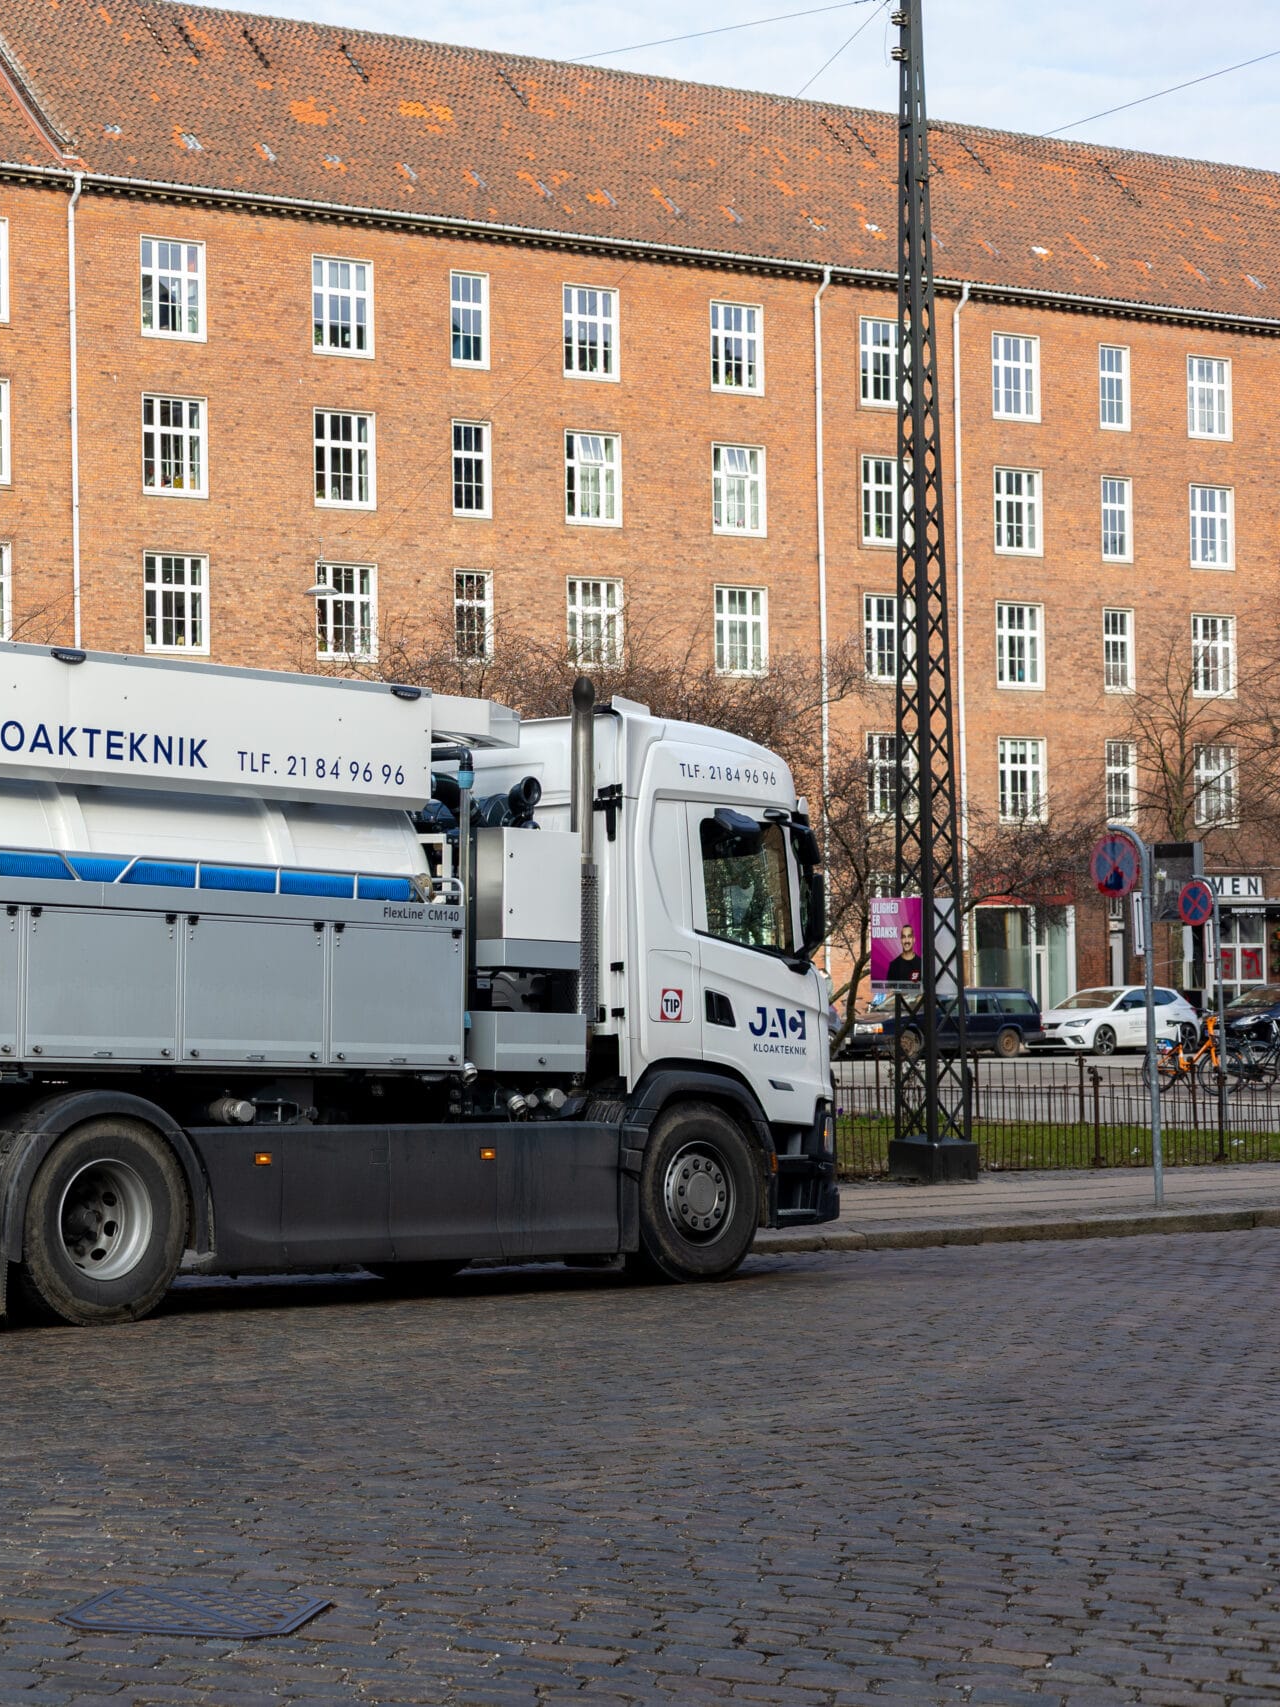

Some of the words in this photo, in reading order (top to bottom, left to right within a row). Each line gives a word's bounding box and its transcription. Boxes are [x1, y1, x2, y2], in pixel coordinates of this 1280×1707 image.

[237, 750, 278, 774] TLF.
[286, 755, 307, 777] 21
[315, 758, 341, 780] 84
[349, 761, 373, 783] 96
[381, 764, 405, 785] 96
[680, 763, 705, 779] TLF.
[709, 765, 721, 780] 21
[725, 767, 740, 782] 84
[744, 769, 759, 784] 96
[762, 771, 777, 786] 96
[1211, 877, 1259, 895] MEN
[428, 909, 460, 922] CM140
[872, 914, 880, 926] ER
[664, 999, 681, 1013] TIP
[748, 1006, 807, 1040] JAC
[753, 1043, 807, 1056] KLOAKTEKNIK
